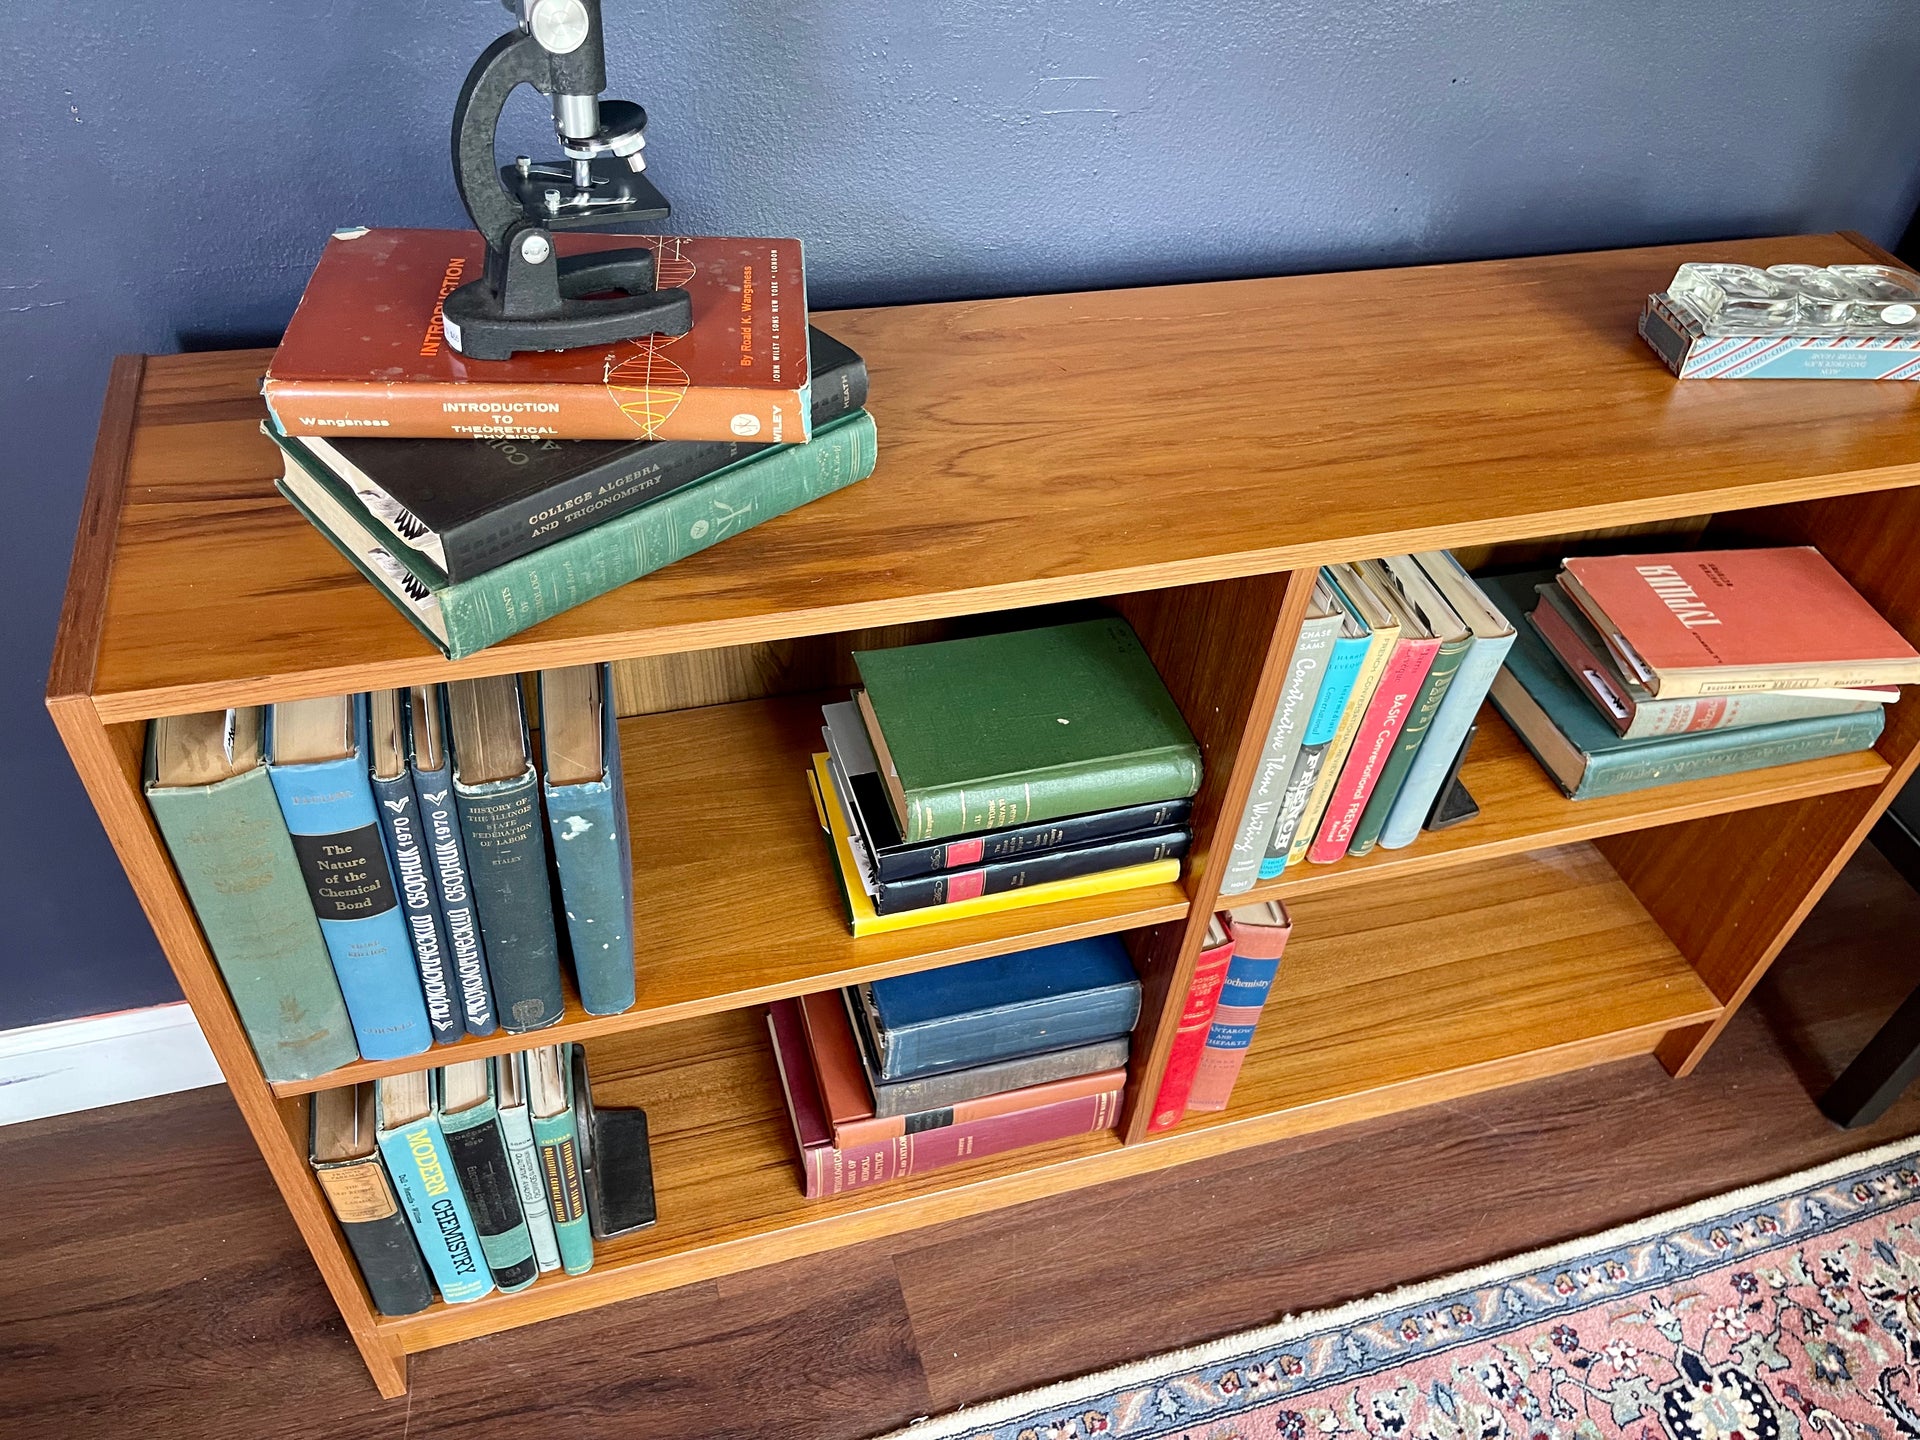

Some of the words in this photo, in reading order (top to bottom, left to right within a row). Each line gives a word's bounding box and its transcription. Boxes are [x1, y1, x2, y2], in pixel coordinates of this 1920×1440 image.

[741, 266, 754, 312] Wangsness
[771, 281, 779, 298] YORK
[420, 258, 465, 357] INTRODCTION
[772, 315, 780, 332] SONS
[741, 327, 752, 351] Roald
[740, 351, 754, 367] By
[772, 342, 781, 361] WILEY
[772, 365, 781, 382] JOHN
[443, 402, 559, 413] INTRODUCTION
[299, 416, 390, 428] Wangsness
[491, 415, 514, 424] TO
[772, 404, 783, 442] WILEY
[451, 425, 559, 434] THEORETICAL
[487, 438, 530, 465] Coll
[528, 491, 593, 525] COLLEGE
[598, 463, 661, 495] ALGEBRA
[531, 519, 560, 538] AND
[565, 475, 663, 523] TRIGONOMETRY
[1301, 628, 1333, 640] CHASE
[1300, 641, 1326, 651] SAMS
[1373, 638, 1390, 672] FRENCH
[1272, 658, 1317, 750] Constructive
[1312, 686, 1336, 735] Conversational
[1383, 693, 1408, 727] BASIC
[1352, 729, 1391, 800] Conversational
[1258, 753, 1287, 797] Theme
[469, 803, 512, 814] HISTORY
[515, 797, 528, 807] OF
[1275, 752, 1320, 850] FRENCH
[492, 804, 532, 821] ILLINOIS
[432, 810, 452, 840] 1970
[472, 822, 533, 838] FEDERATION
[486, 819, 517, 830] STATE
[1233, 800, 1273, 853] Writing
[1335, 802, 1360, 842] FRENCH
[393, 817, 418, 848] 1970
[496, 833, 527, 846] LABOR
[322, 845, 353, 856] The
[317, 857, 367, 871] Nature
[325, 874, 340, 885] of
[344, 871, 367, 883] the
[318, 880, 382, 898] Chemical
[335, 898, 373, 911] Bond
[1223, 975, 1272, 989] iochemistry
[1210, 1025, 1253, 1034] ANTAROW
[544, 1147, 558, 1178] QUALITATIVE
[563, 1141, 576, 1180] INTRODUCTION
[569, 1179, 577, 1189] TO
[406, 1129, 449, 1198] MODERN
[431, 1198, 477, 1276] CHEMISTRY
